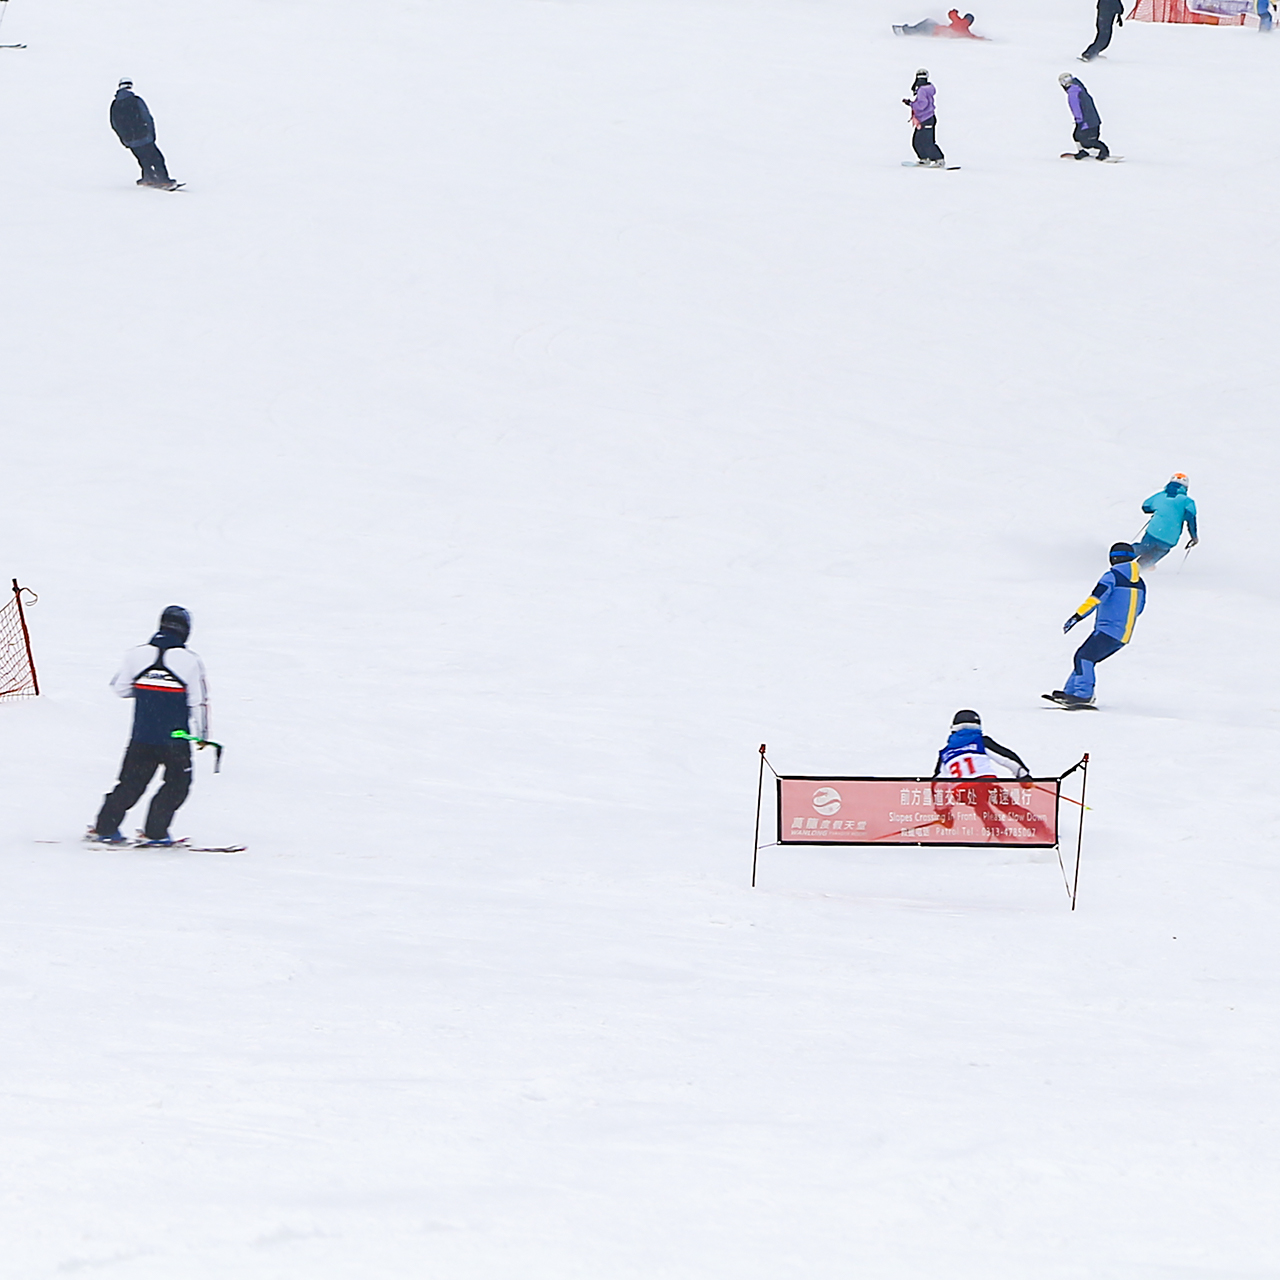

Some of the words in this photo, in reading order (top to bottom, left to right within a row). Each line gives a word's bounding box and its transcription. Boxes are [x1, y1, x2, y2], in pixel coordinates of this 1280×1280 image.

[949, 757, 977, 778] 31
[899, 788, 978, 806] 前方雪道交汇处
[987, 788, 1033, 806] 减速慢行
[888, 812, 913, 824] Slopes
[914, 812, 946, 824] Crossing
[957, 812, 977, 822] Front
[982, 812, 1006, 822] Please
[1007, 812, 1025, 822] Slow
[1026, 812, 1048, 822] Down
[935, 828, 960, 837] Patrol
